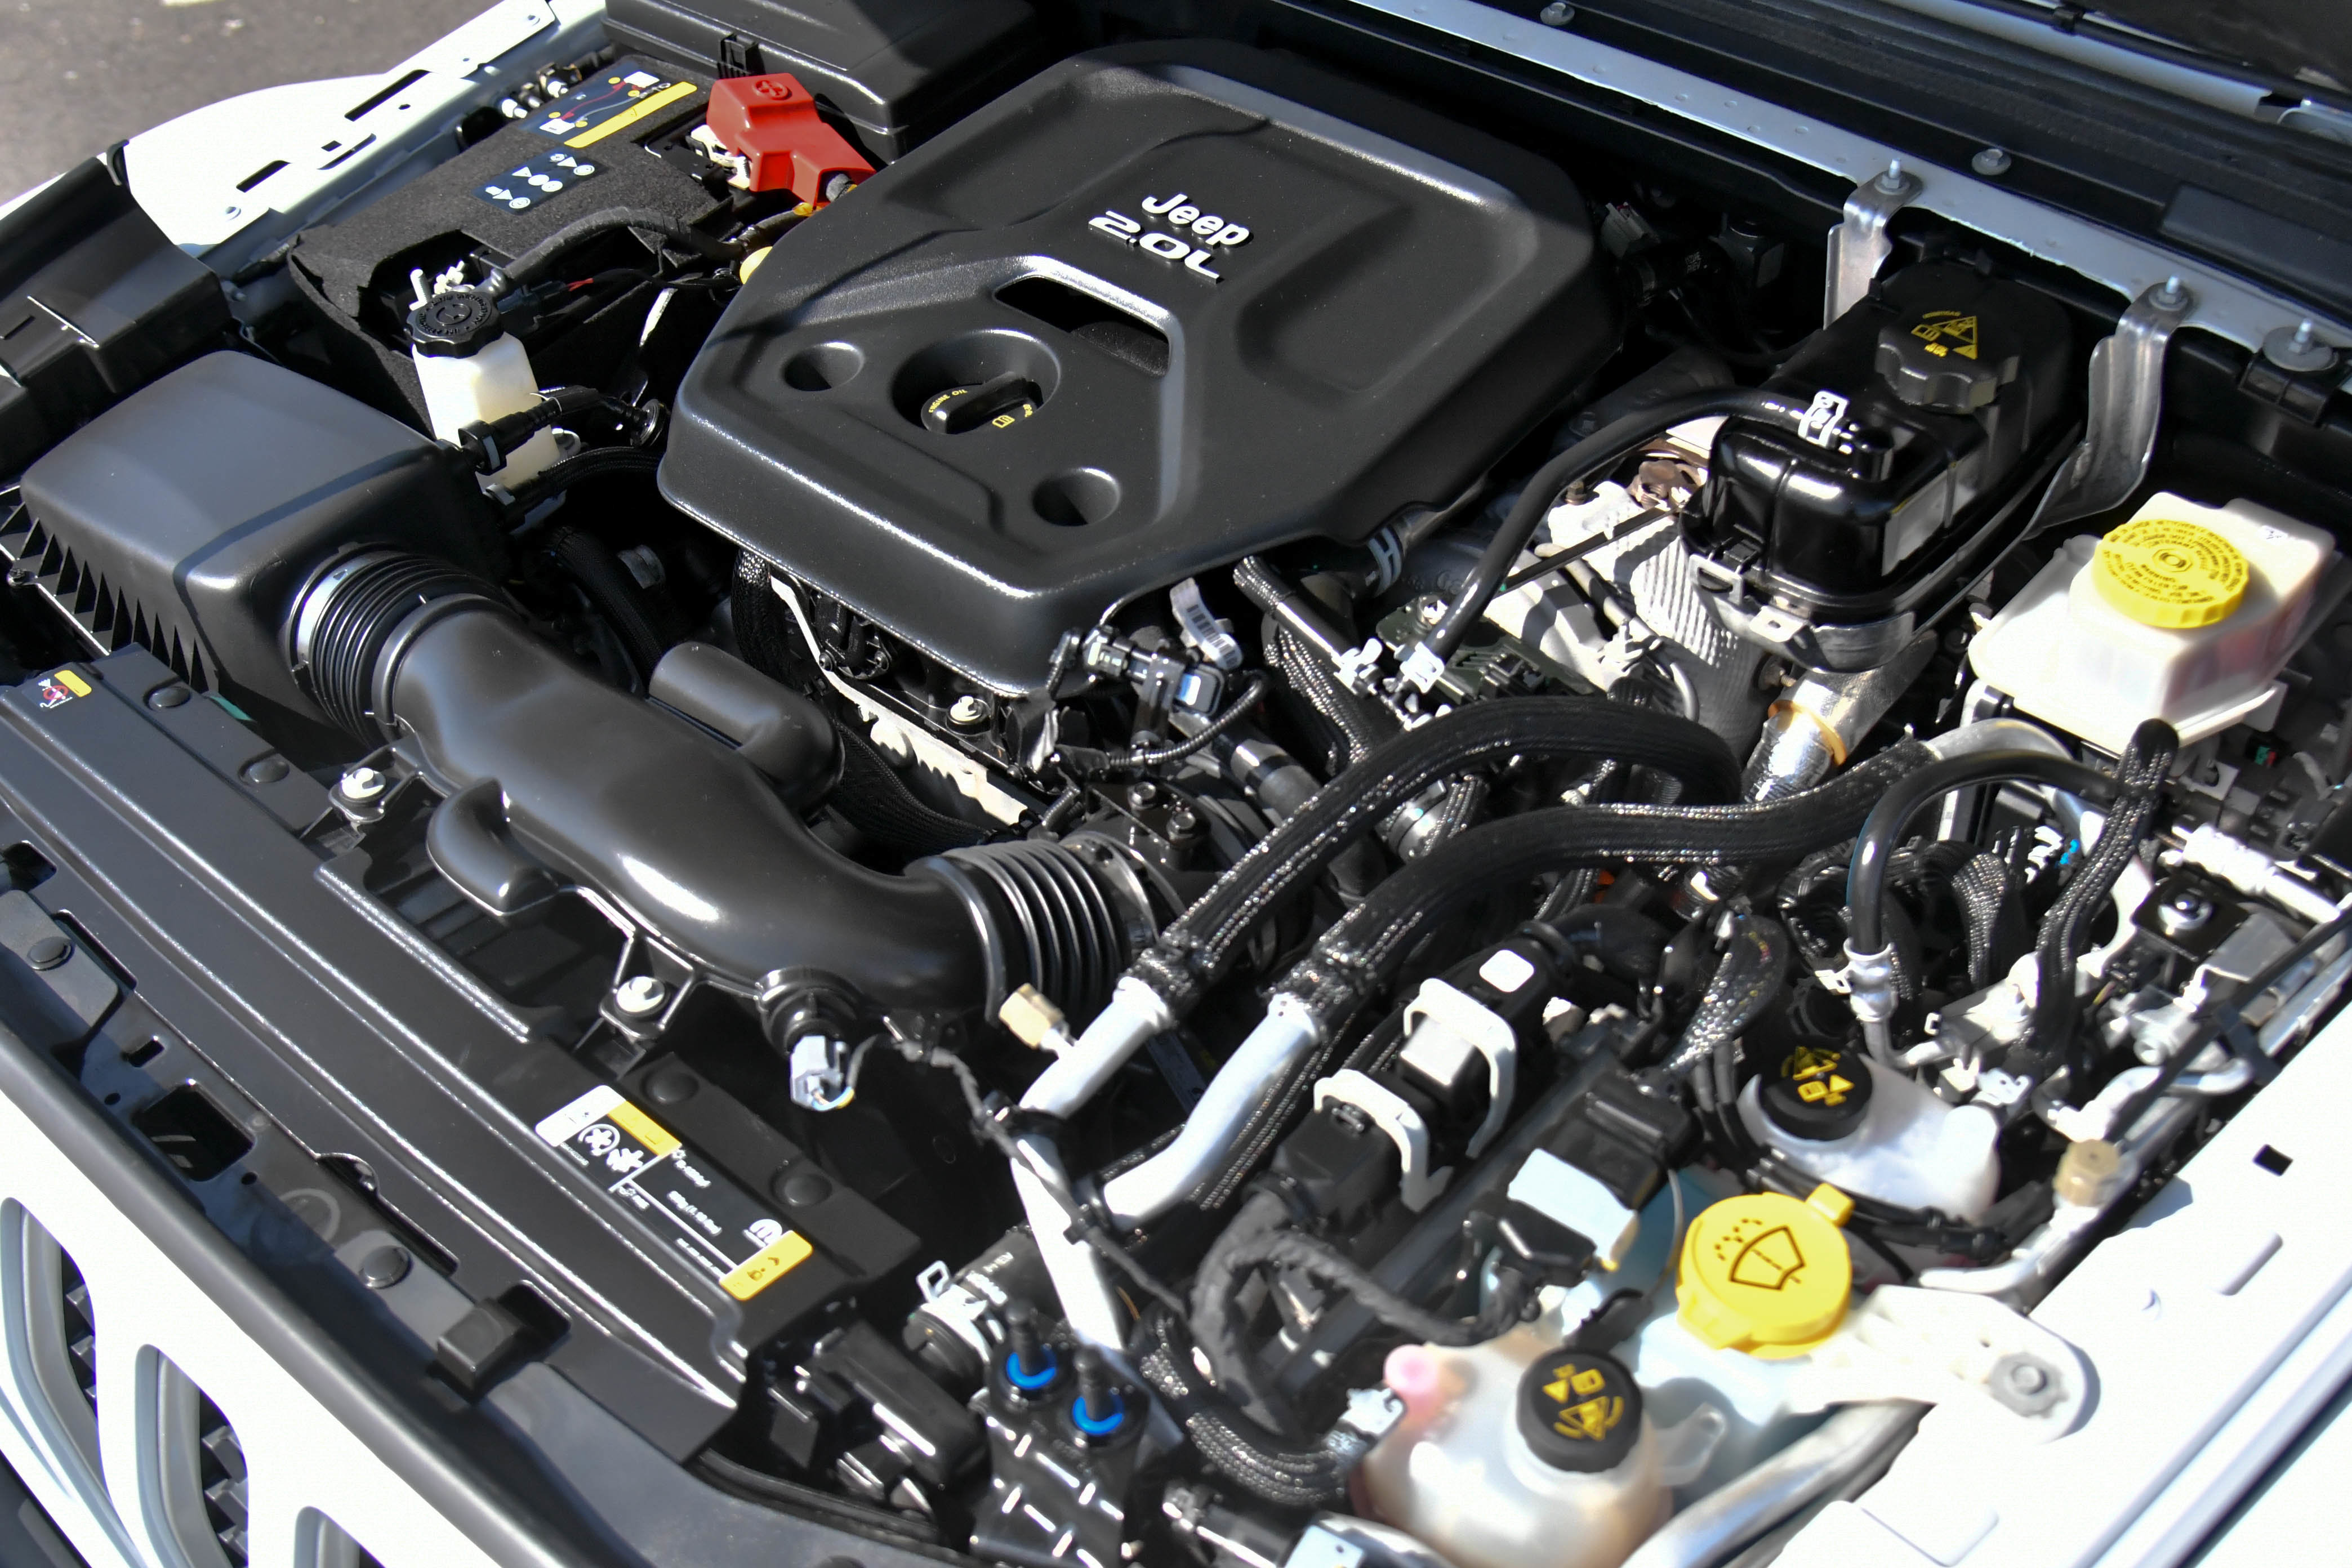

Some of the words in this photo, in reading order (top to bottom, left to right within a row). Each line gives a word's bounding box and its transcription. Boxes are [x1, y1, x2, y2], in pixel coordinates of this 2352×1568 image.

[1088, 210, 1220, 283] 2.0L
[1141, 193, 1250, 248] Jeep
[928, 394, 951, 413] ENGINE
